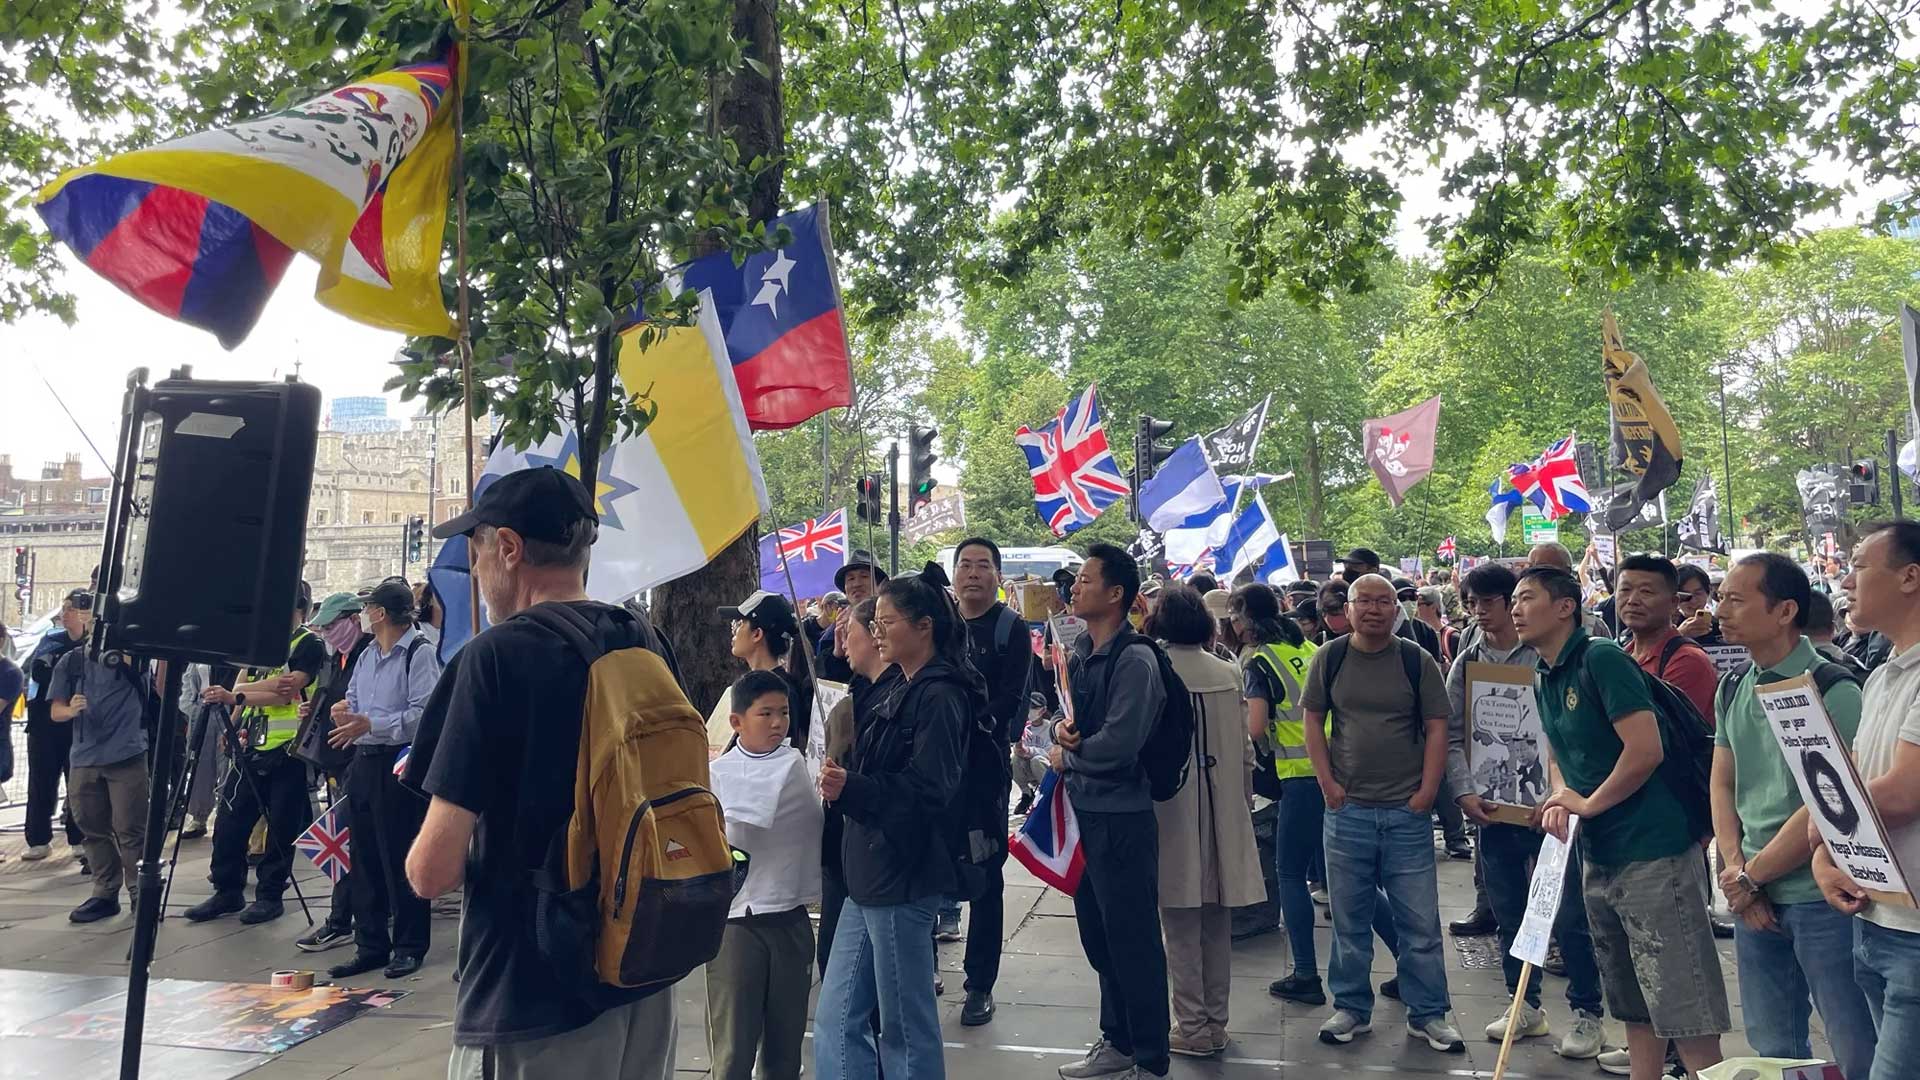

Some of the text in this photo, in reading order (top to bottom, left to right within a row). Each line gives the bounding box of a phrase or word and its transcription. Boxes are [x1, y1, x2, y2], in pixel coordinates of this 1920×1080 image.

[1289, 656, 1304, 675] P
[1799, 734, 1831, 749] Spending
[1827, 839, 1889, 864] Mega Embassy
[1847, 863, 1888, 884] Blackhole
